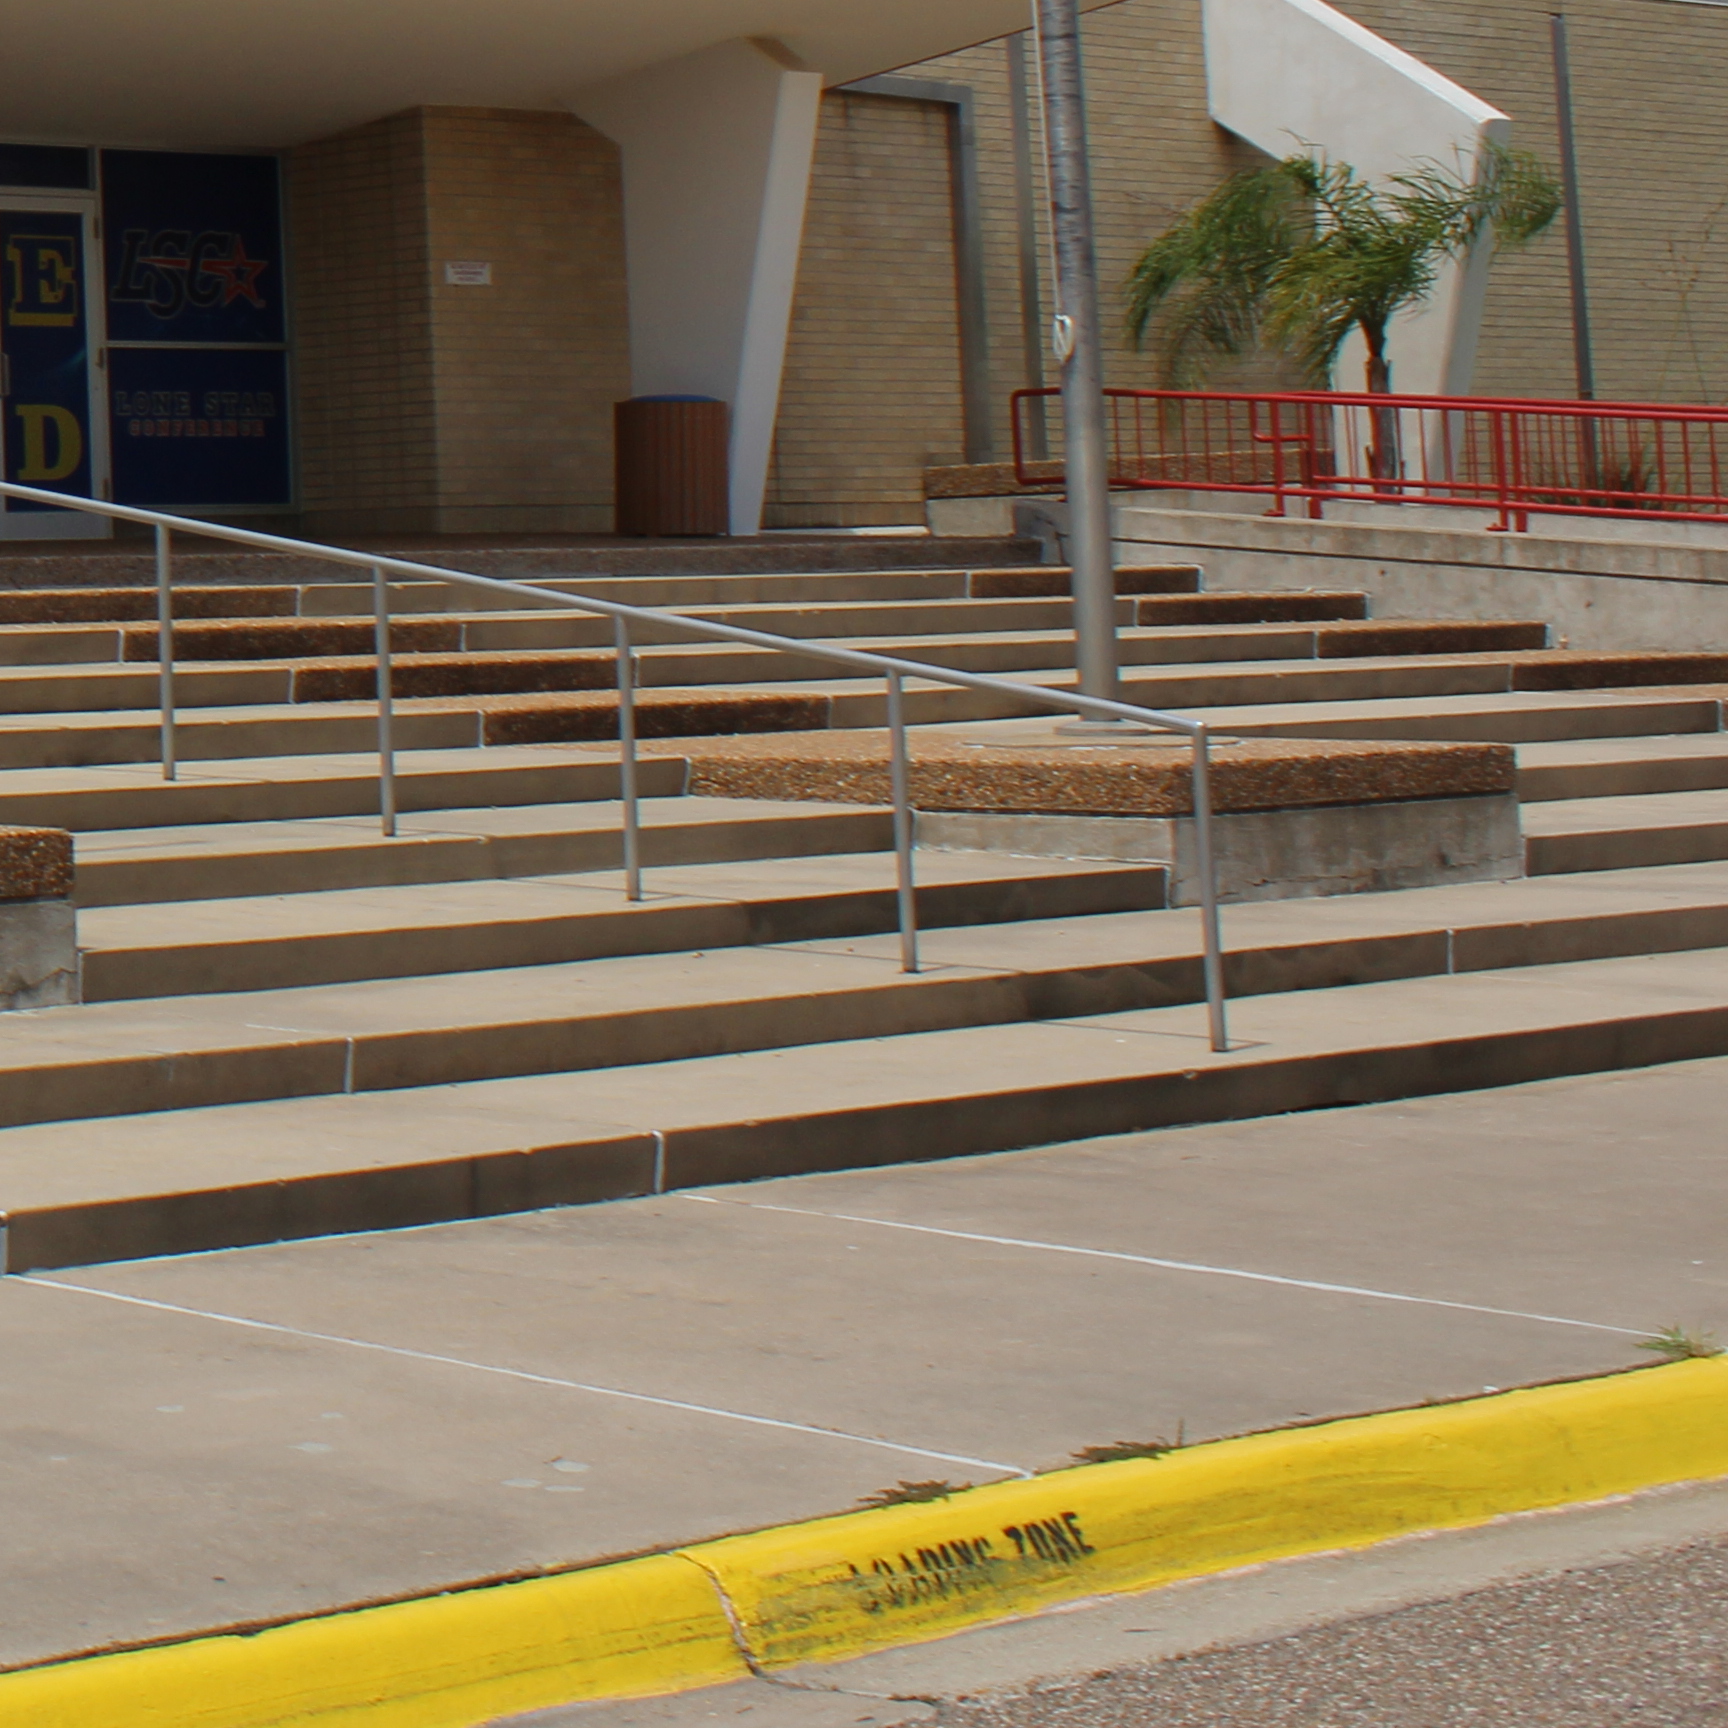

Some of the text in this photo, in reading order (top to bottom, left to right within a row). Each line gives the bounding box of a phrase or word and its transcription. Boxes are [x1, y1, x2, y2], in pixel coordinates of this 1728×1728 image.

[115, 391, 277, 418] LONE STAR
[128, 418, 266, 437] CONFERENCE
[1002, 1511, 1097, 1565] ZONE
